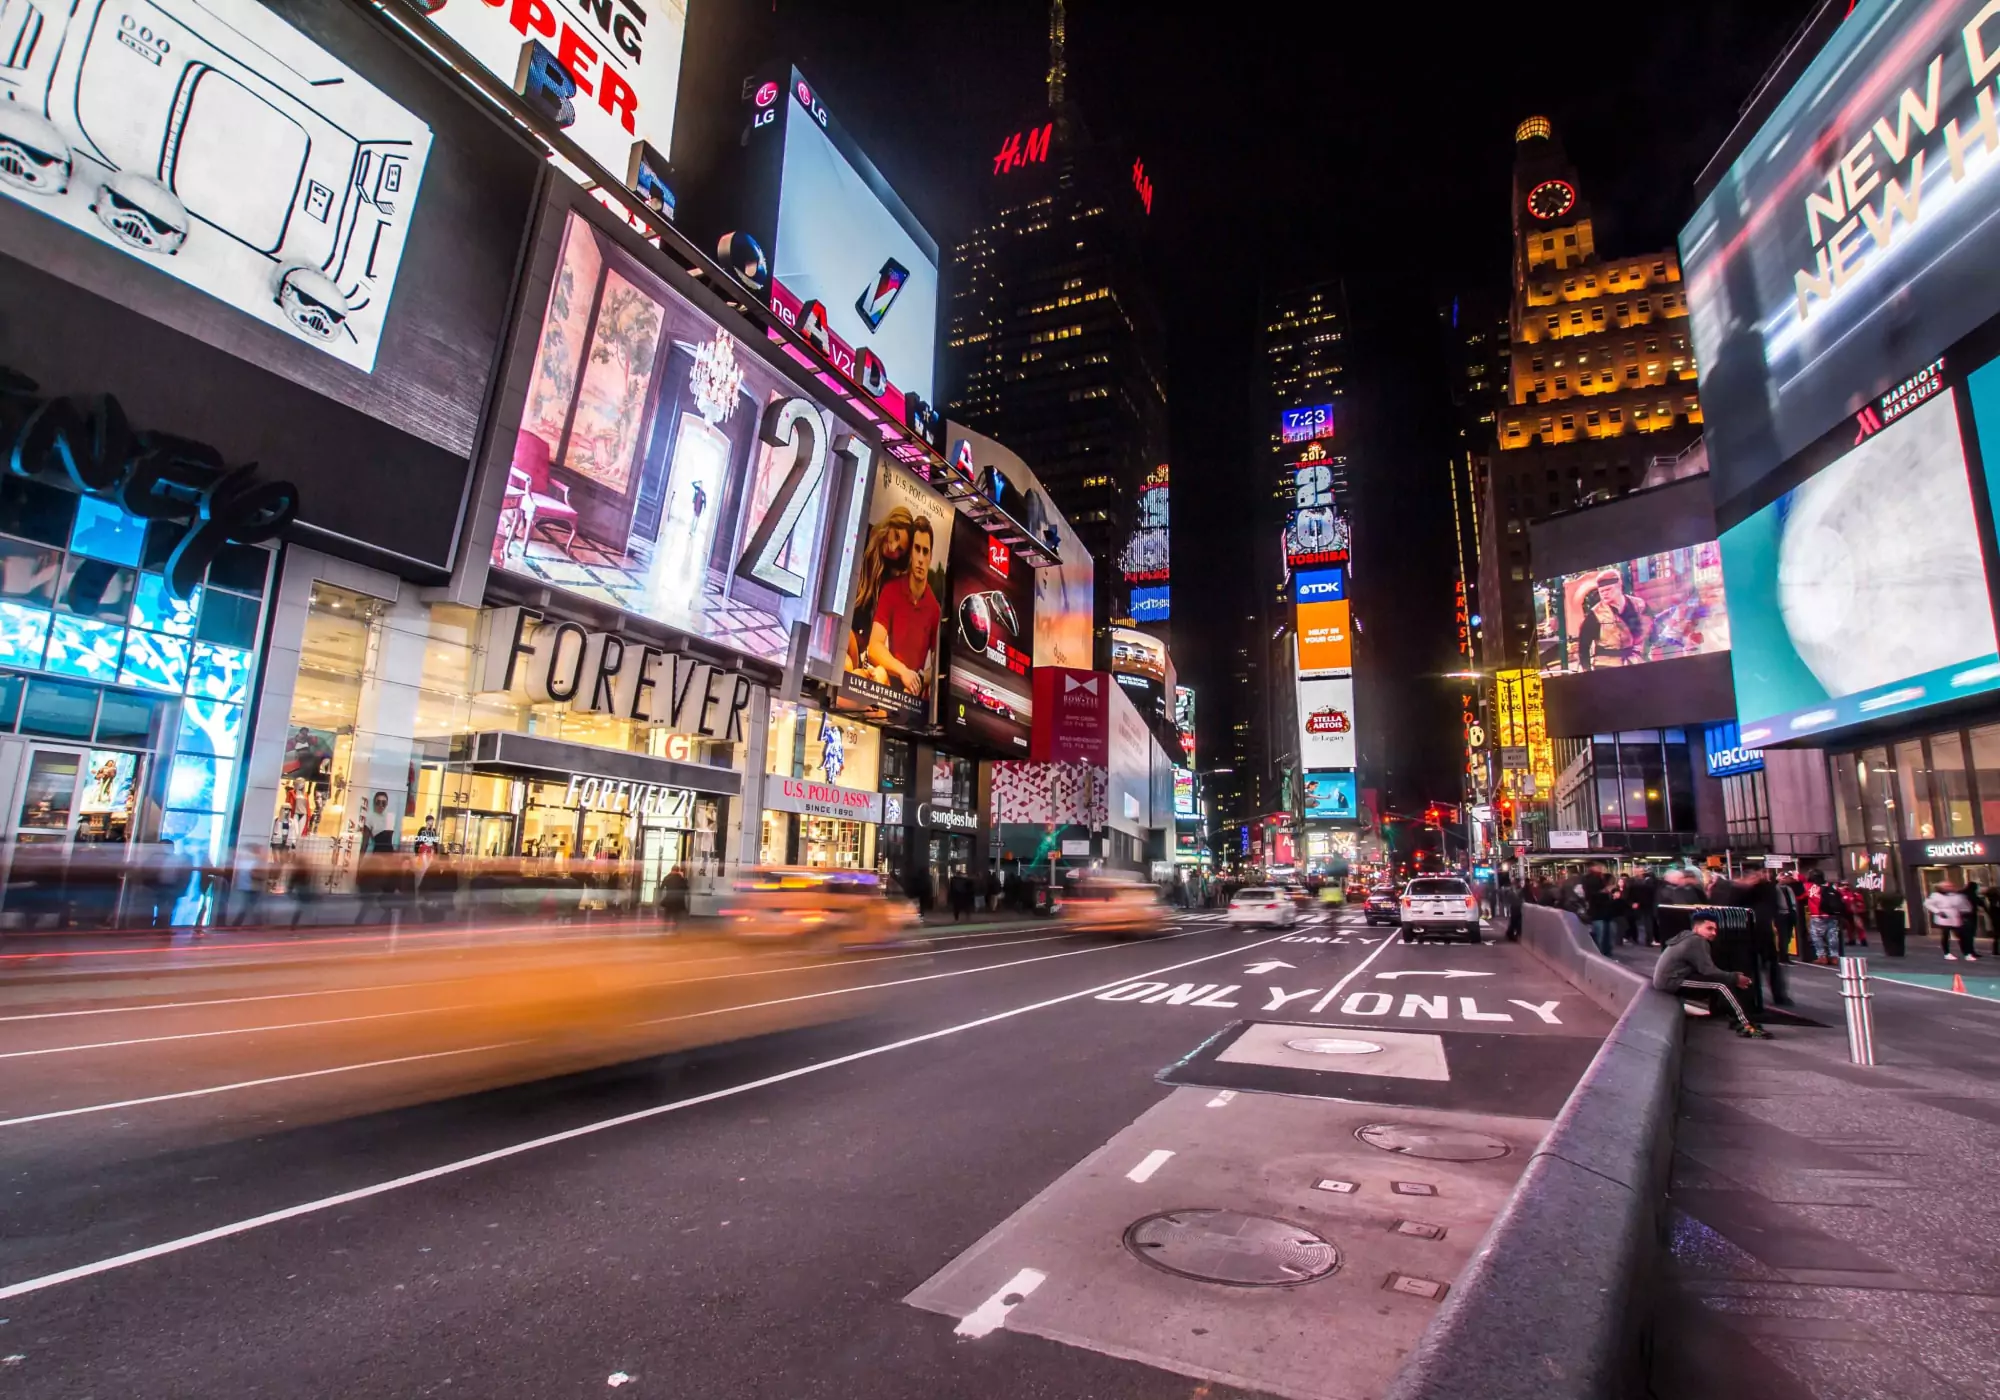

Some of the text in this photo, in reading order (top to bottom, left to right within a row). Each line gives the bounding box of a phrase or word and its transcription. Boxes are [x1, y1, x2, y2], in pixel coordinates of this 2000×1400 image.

[482, 0, 638, 137] PER
[754, 109, 776, 129] LG
[811, 98, 828, 128] LG
[994, 123, 1053, 175] H&M
[1806, 54, 1943, 247] NEW
[1794, 76, 2000, 322] NEW H
[1881, 357, 1946, 409] MARRIOTT
[1883, 375, 1941, 423] MARQUIS
[1289, 410, 1326, 428] 7:23
[736, 396, 872, 617] 21
[1288, 550, 1349, 566] TOSHIBA
[1309, 582, 1339, 594] TDK
[1455, 581, 1468, 654] ERNST
[480, 605, 752, 743] FOREVER
[849, 676, 868, 689] LIVE
[870, 683, 922, 707] AUTHENTICALLY
[1313, 716, 1343, 724] STELLA
[1313, 722, 1343, 730] ARTOIS
[564, 774, 698, 820] FOREVER 21
[784, 780, 873, 808] U.S. POLO ASSN.
[805, 803, 853, 816] SINCE 1890
[932, 811, 978, 829] sunglass hut
[1926, 841, 1974, 857] swatch
[1280, 936, 1382, 945] ONLY
[1094, 981, 1322, 1013] ONLY
[1340, 991, 1565, 1026] ONLY
